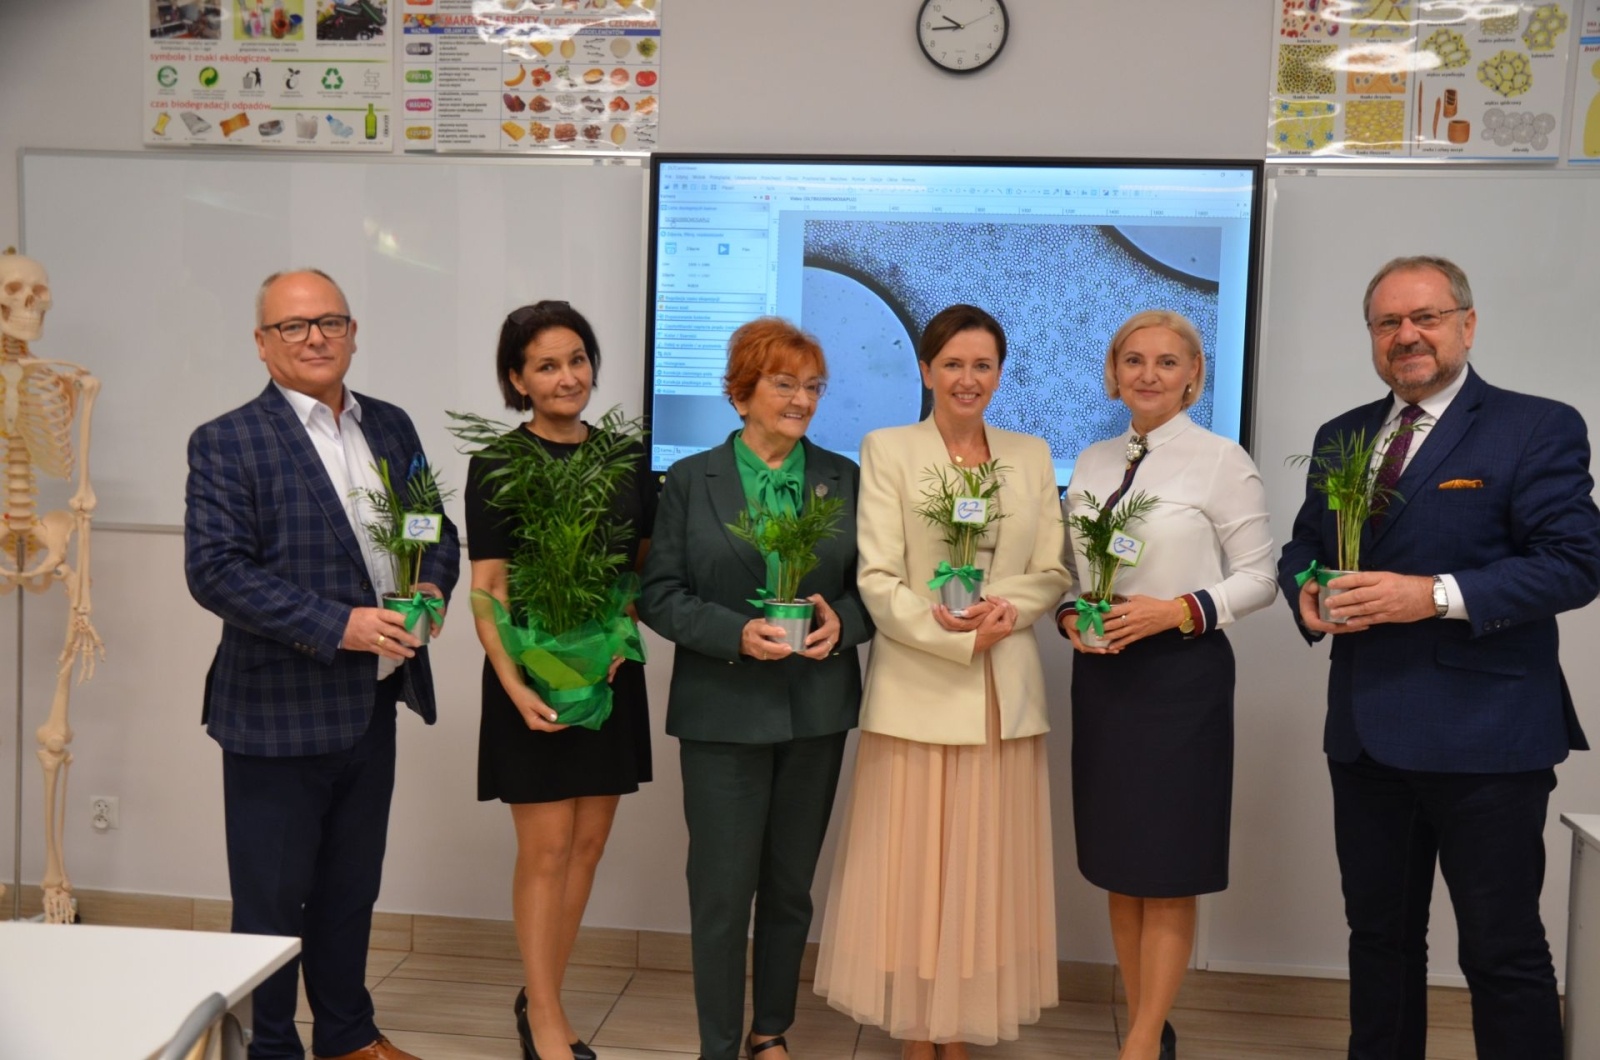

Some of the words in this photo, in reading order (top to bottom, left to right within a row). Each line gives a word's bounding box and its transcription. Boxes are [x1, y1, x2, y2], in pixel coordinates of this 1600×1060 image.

[150, 52, 186, 62] symbole
[194, 53, 217, 61] znaki
[220, 54, 272, 64] ekologiczne
[171, 100, 230, 110] biodegradacji
[232, 102, 271, 110] odpadów
